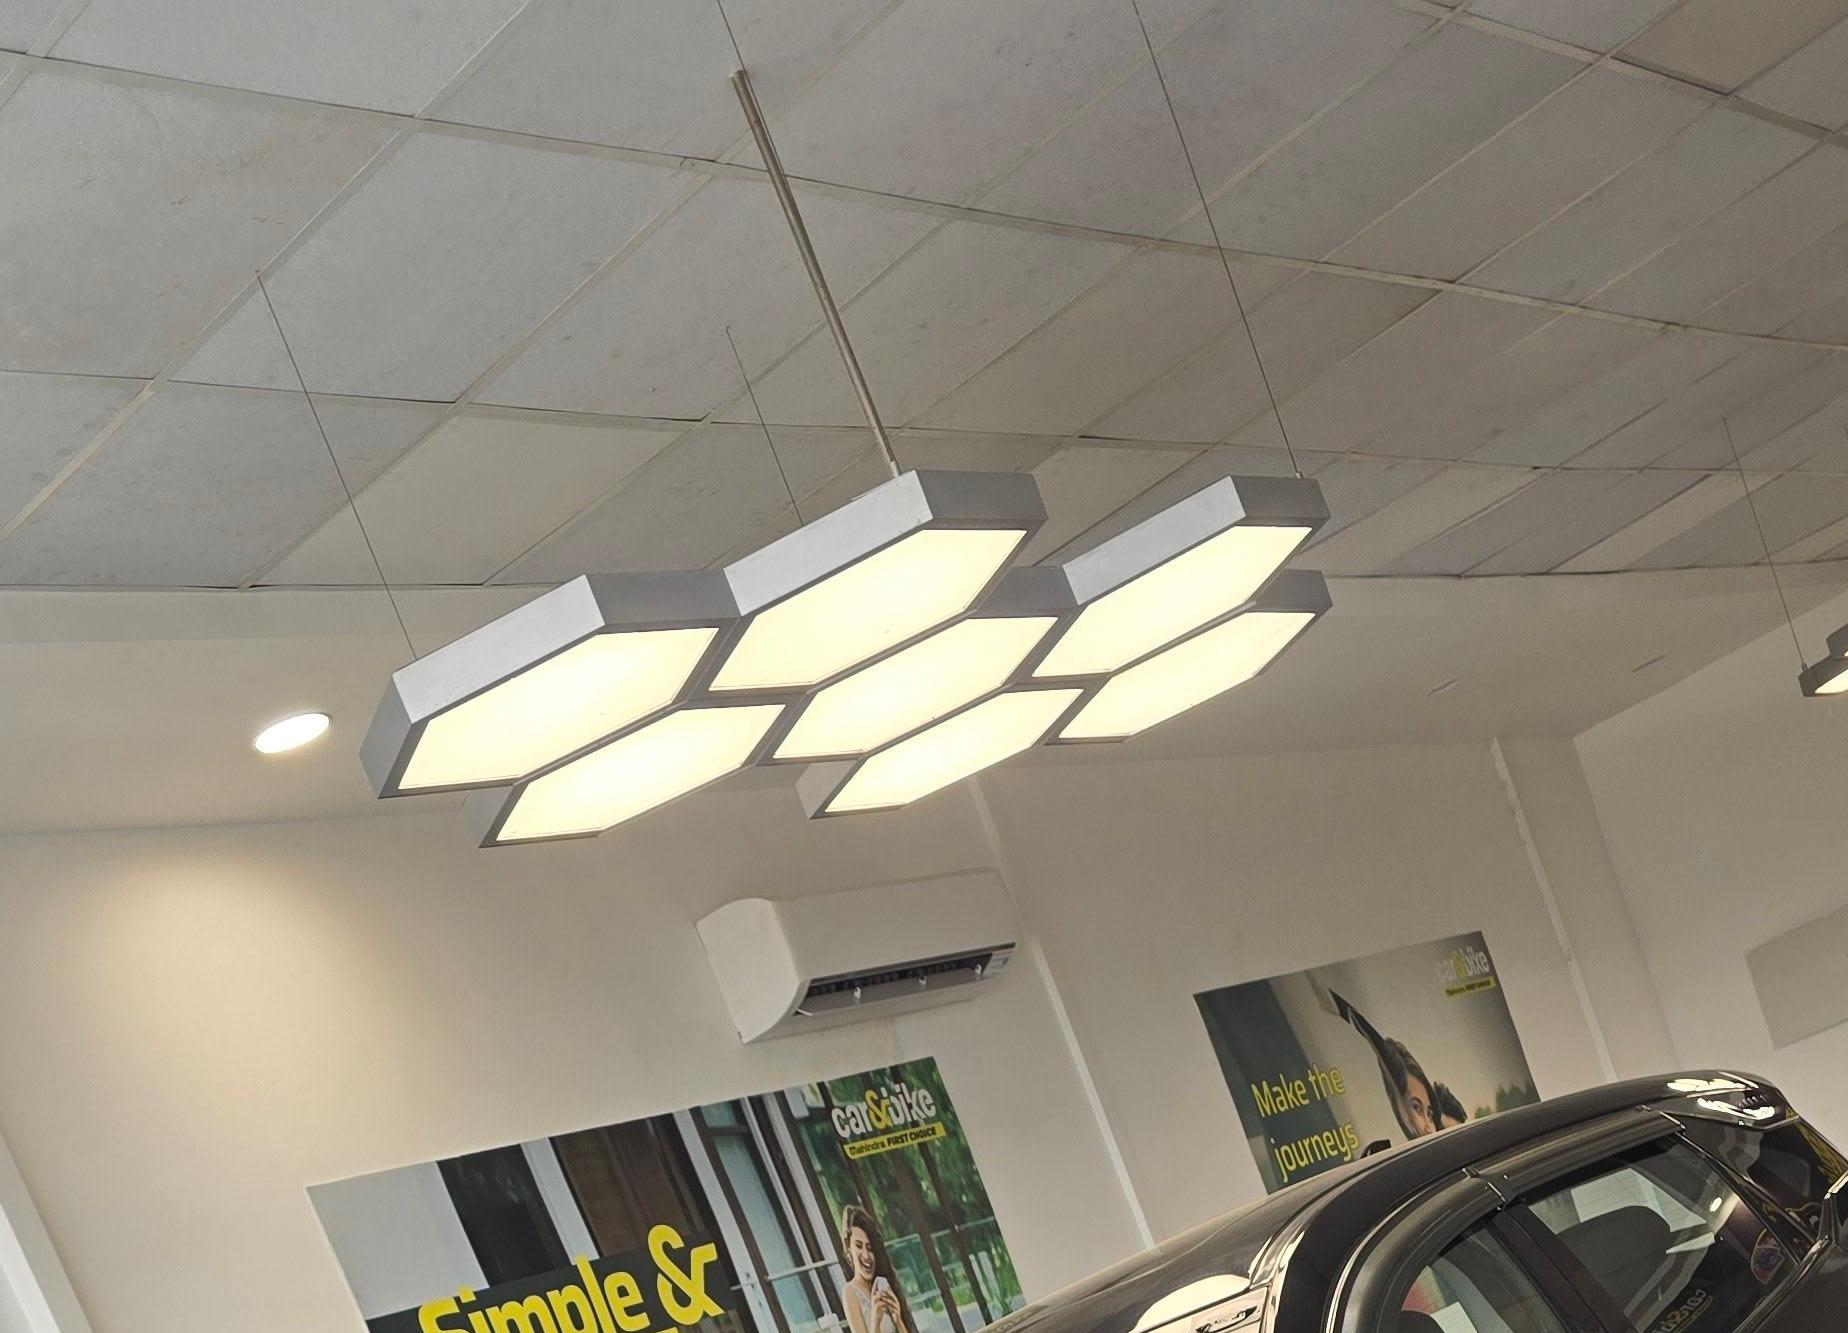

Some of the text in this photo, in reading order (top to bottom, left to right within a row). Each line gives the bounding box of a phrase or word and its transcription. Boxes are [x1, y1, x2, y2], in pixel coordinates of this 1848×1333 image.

[831, 1082, 937, 1138] car&bike
[1251, 1064, 1345, 1118] Make the
[849, 1126, 937, 1156] Mahindra FIRST CHOICE
[1270, 1123, 1359, 1183] journeys
[647, 1224, 726, 1326] &
